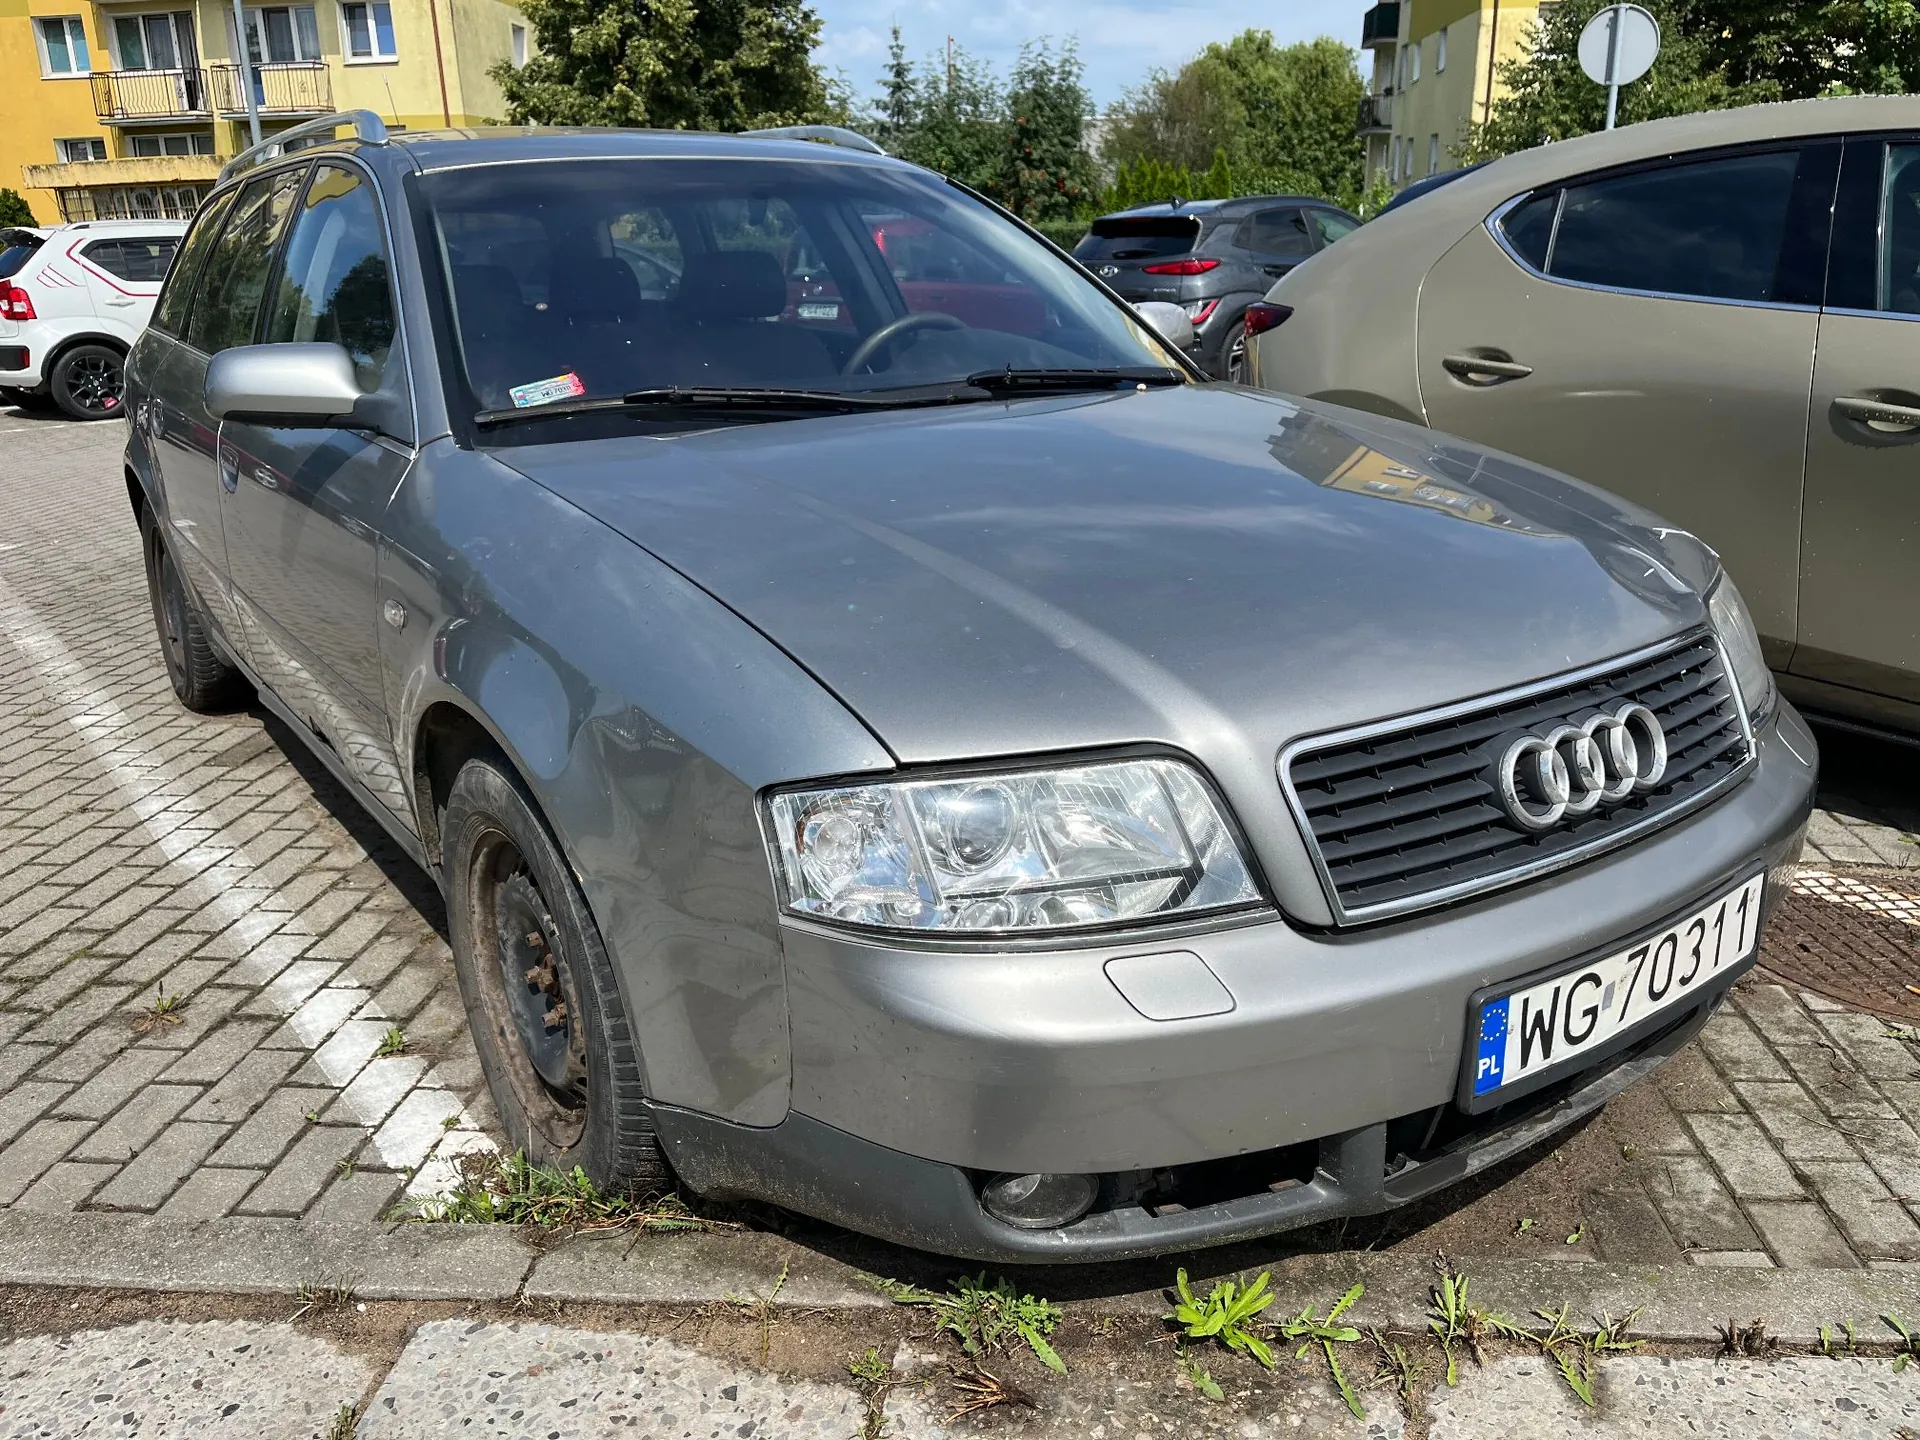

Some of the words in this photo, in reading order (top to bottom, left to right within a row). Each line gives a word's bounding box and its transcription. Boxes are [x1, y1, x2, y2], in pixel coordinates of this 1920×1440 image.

[1519, 972, 1602, 1071] WG
[1618, 886, 1751, 1023] 70311
[1477, 1057, 1500, 1080] PL
